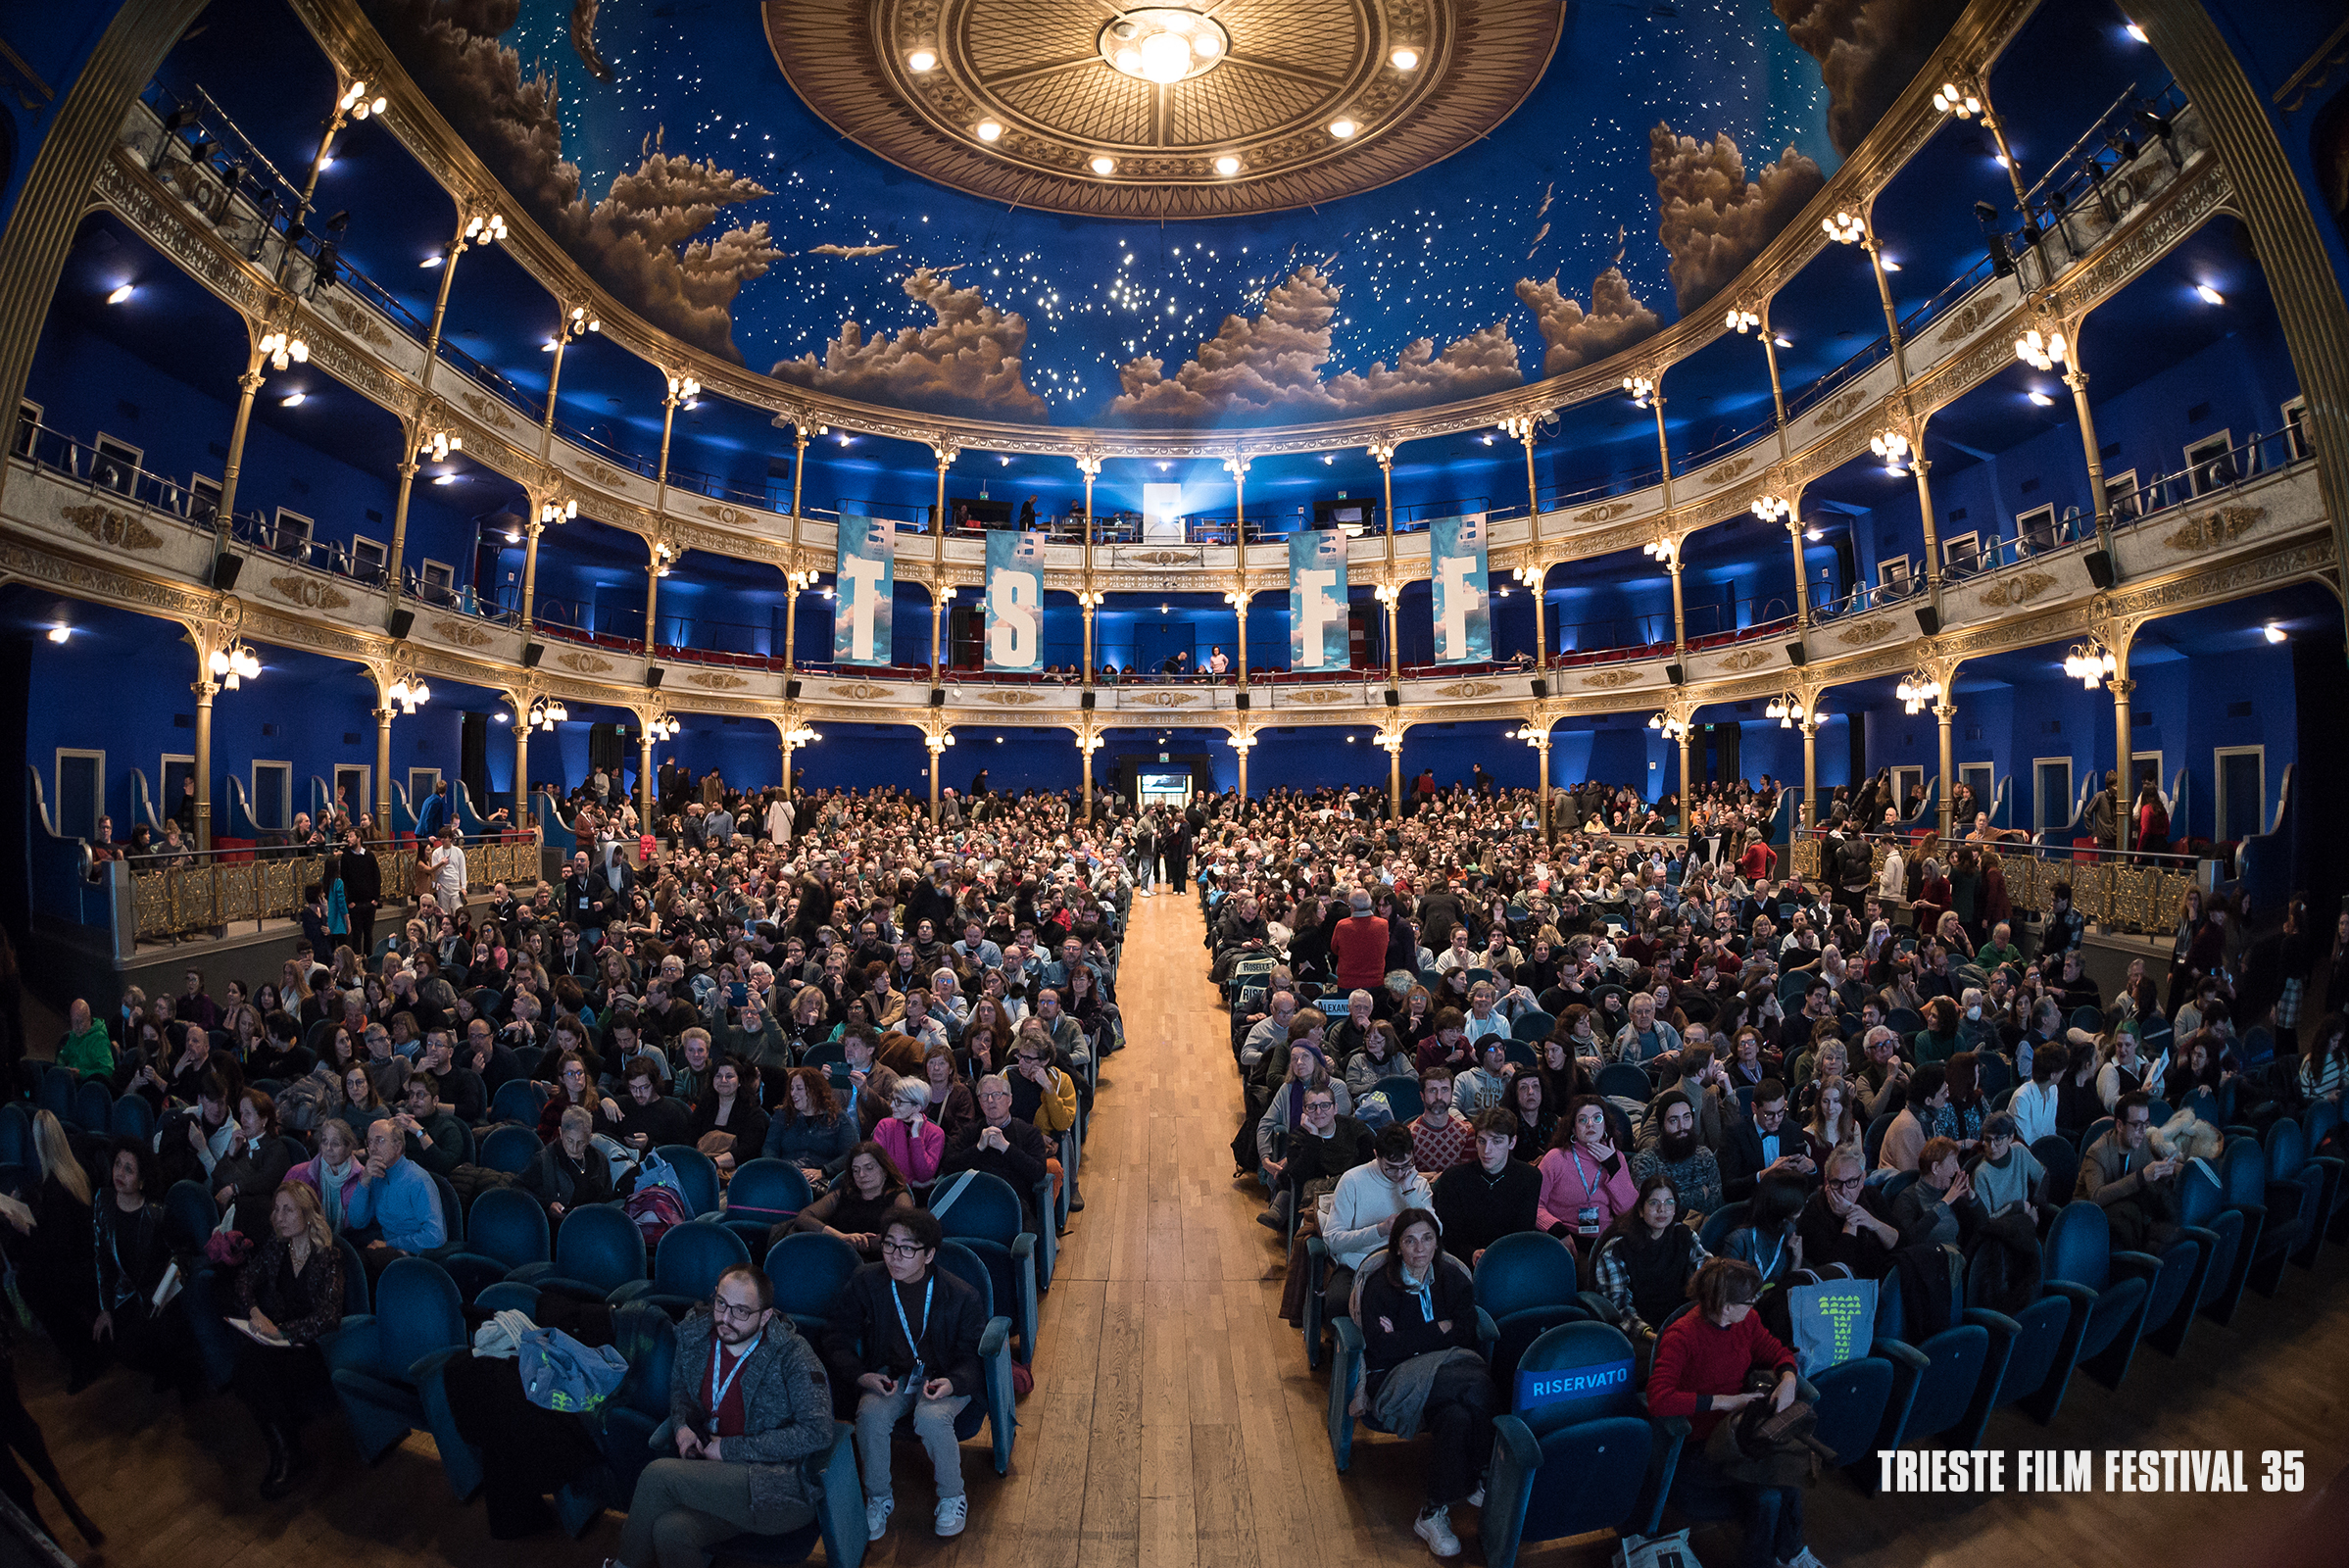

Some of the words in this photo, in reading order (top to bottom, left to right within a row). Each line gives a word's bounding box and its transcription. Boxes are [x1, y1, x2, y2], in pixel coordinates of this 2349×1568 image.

[846, 557, 885, 661] T
[992, 571, 1037, 667] S
[1301, 569, 1338, 667] F
[1444, 556, 1479, 660] F
[1533, 1368, 1627, 1396] RISERVATO
